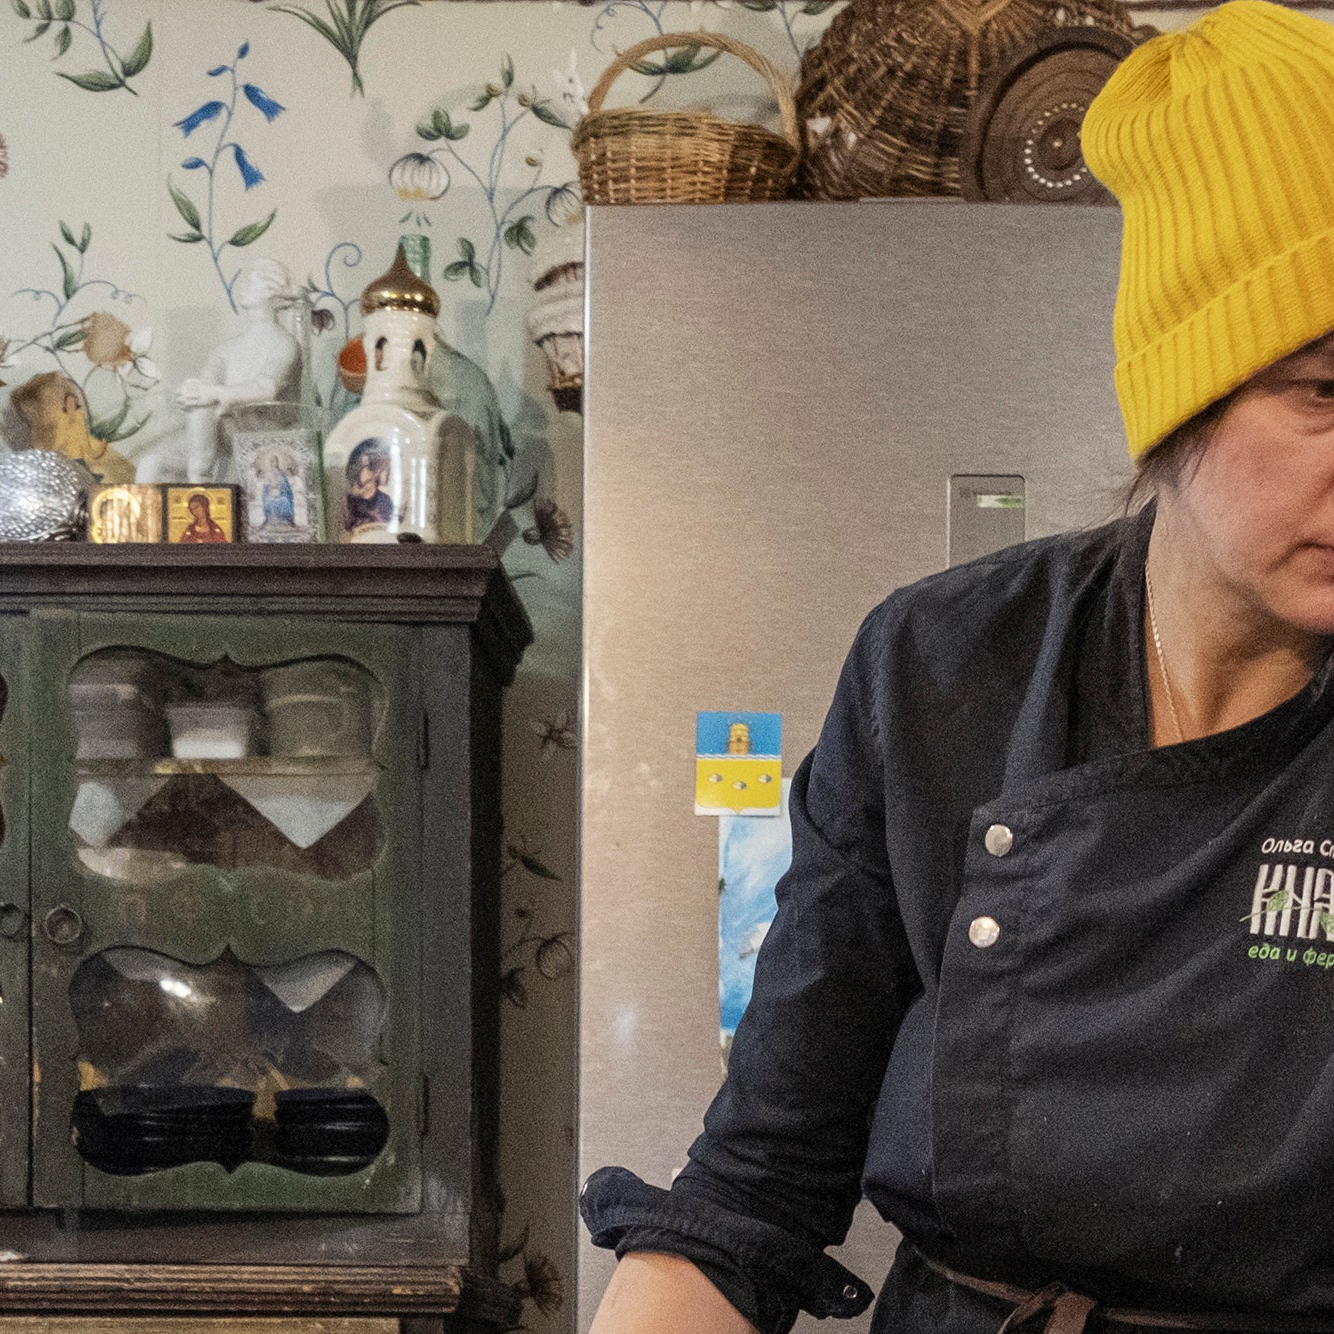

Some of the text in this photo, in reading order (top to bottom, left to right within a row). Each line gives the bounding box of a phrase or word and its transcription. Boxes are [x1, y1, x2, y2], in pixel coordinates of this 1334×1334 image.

[1261, 837, 1315, 854] Ольга
[1248, 943, 1281, 960] еда
[1286, 950, 1297, 961] и
